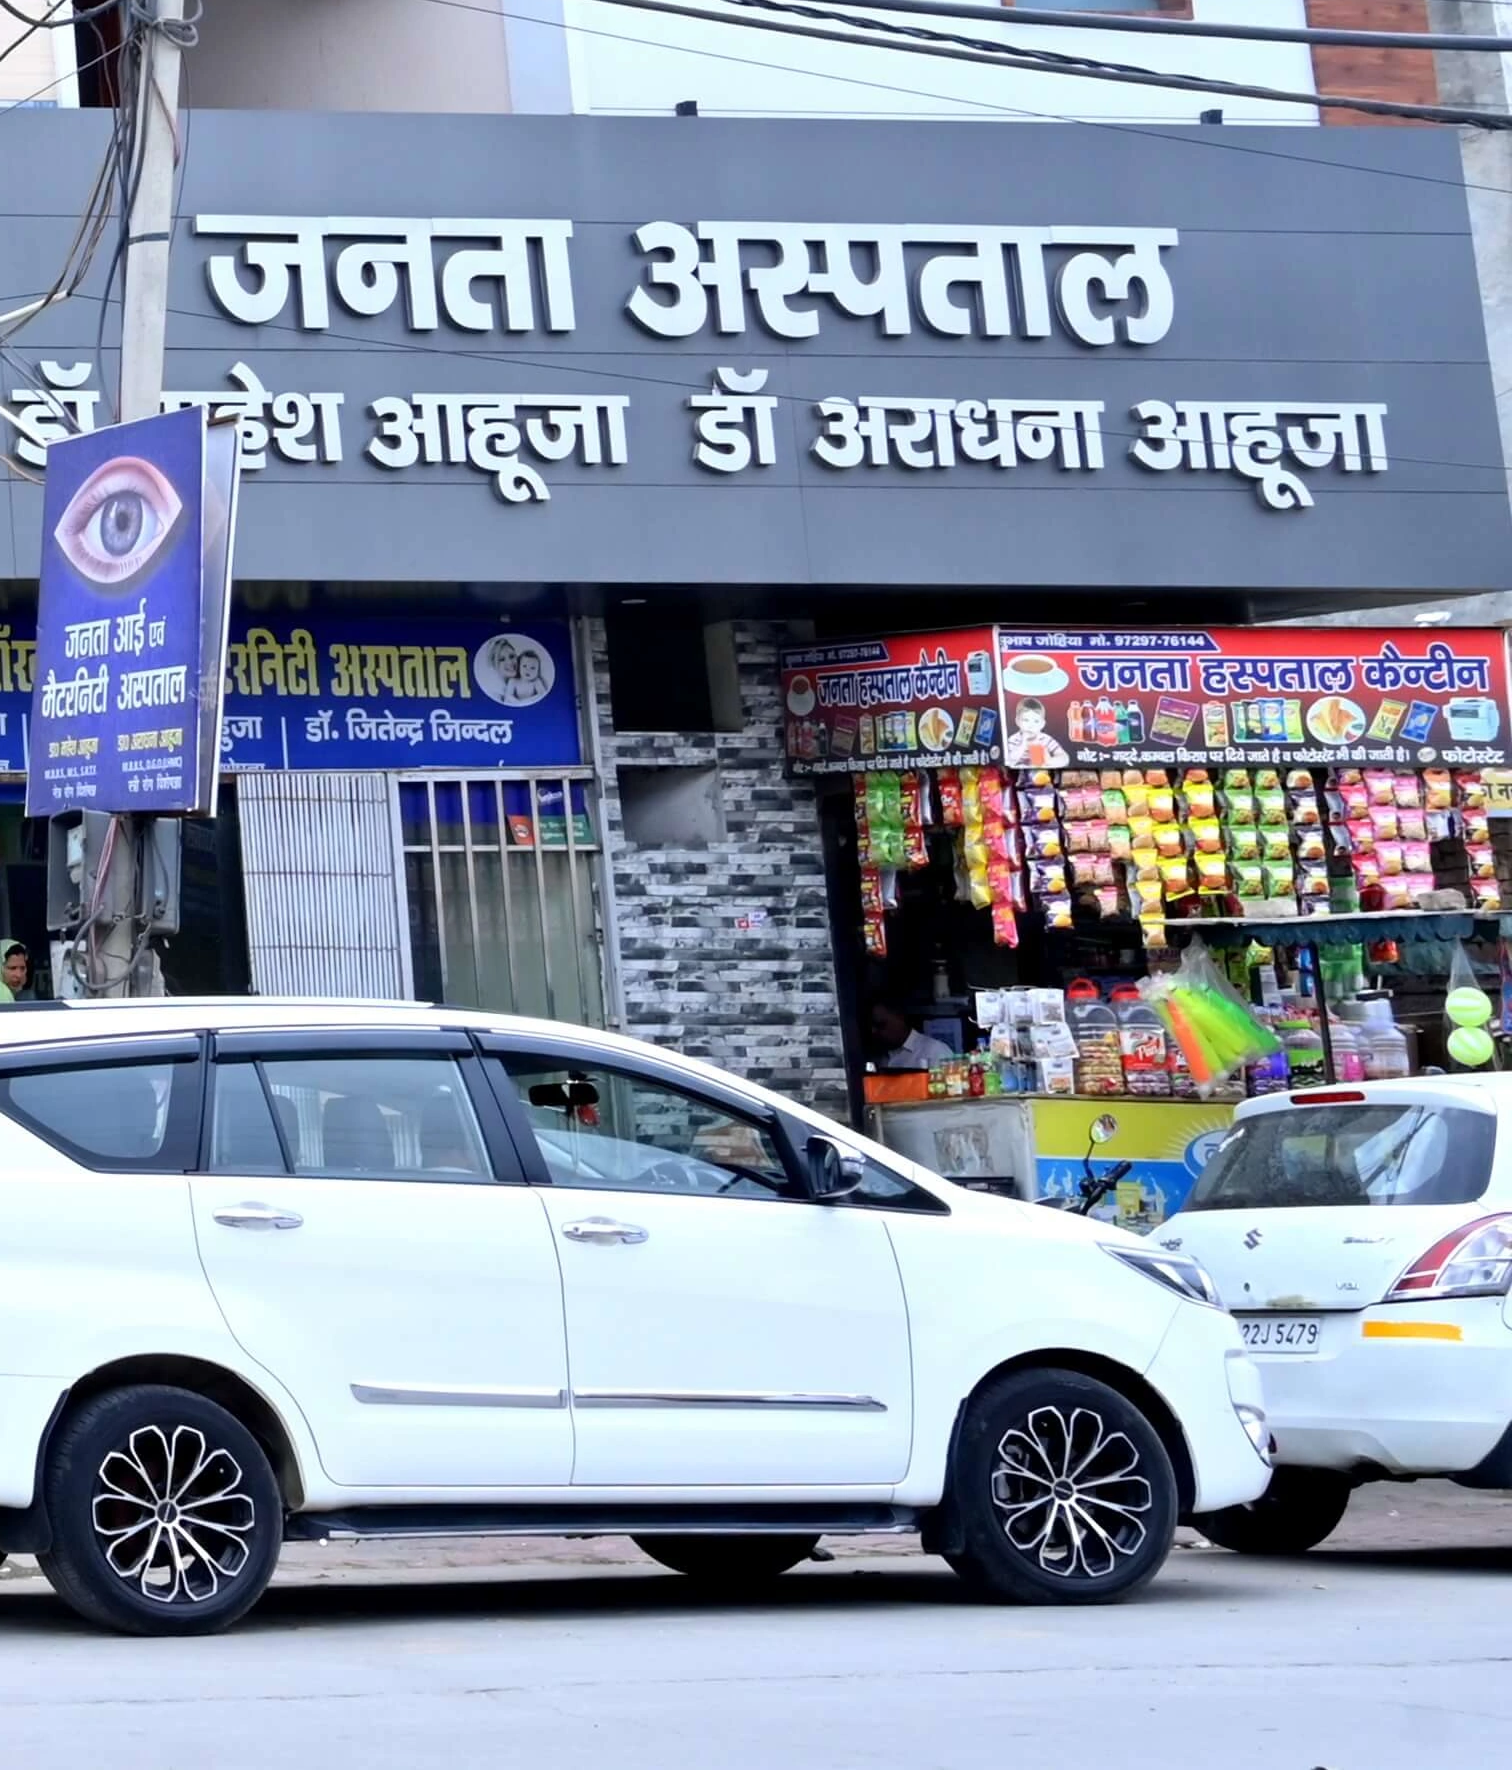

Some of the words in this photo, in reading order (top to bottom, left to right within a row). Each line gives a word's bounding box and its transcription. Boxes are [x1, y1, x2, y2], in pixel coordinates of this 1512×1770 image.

[196, 213, 575, 333] जनता
[625, 218, 1178, 347] अस्पताल
[368, 390, 630, 502] आहूजा
[690, 366, 777, 471] डॉ
[812, 397, 1105, 471] अराधना
[1132, 399, 1390, 510] आहूजा
[65, 617, 111, 660] जनता
[113, 597, 148, 656] आई
[148, 615, 167, 649] एवं
[1114, 634, 1206, 648] 97297-76144
[41, 663, 110, 721] मैटरनिटी
[117, 664, 188, 712] अस्पताल
[329, 643, 472, 700] अस्पताल
[816, 670, 857, 708] जनता
[856, 666, 913, 709] हस्पताल
[1074, 655, 1191, 693] जनता
[1198, 655, 1357, 696] हस्पताल
[1360, 640, 1491, 695] कैन्टीन
[305, 710, 339, 743] डॉ.
[345, 707, 425, 747] जितेन्द्र
[429, 708, 514, 745] जिन्दल
[1274, 1321, 1318, 1345] 5479
